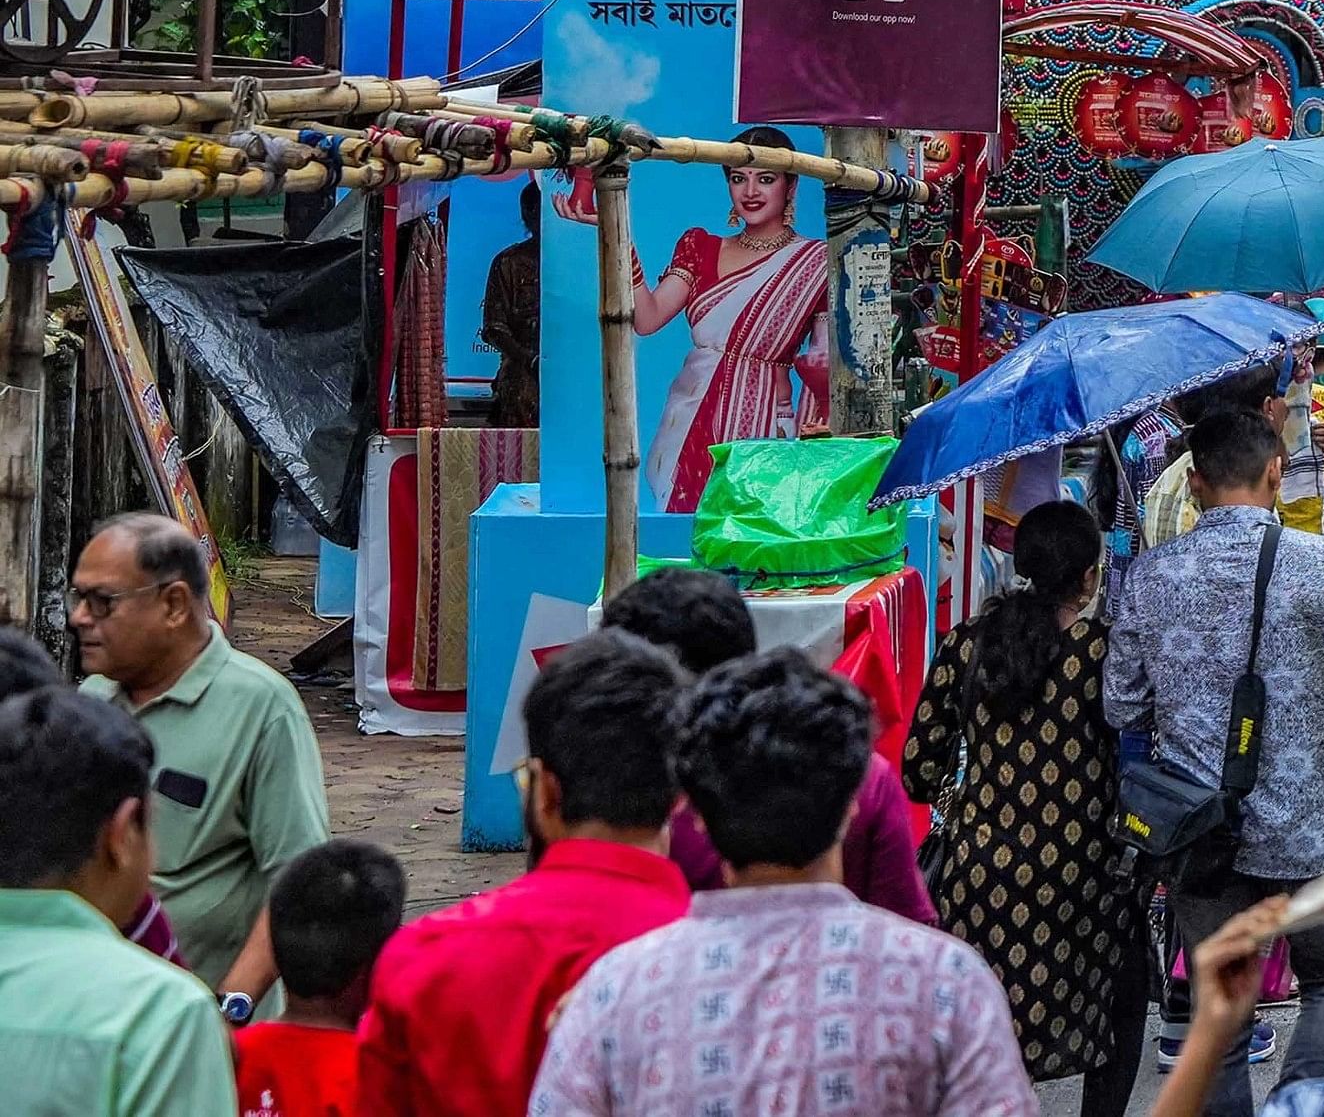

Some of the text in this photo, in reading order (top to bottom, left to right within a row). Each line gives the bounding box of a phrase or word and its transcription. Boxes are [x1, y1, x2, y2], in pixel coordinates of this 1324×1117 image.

[832, 10, 869, 21] Download
[882, 15, 897, 24] app
[1238, 717, 1254, 756] Nikon
[1125, 813, 1151, 838] Nikon
